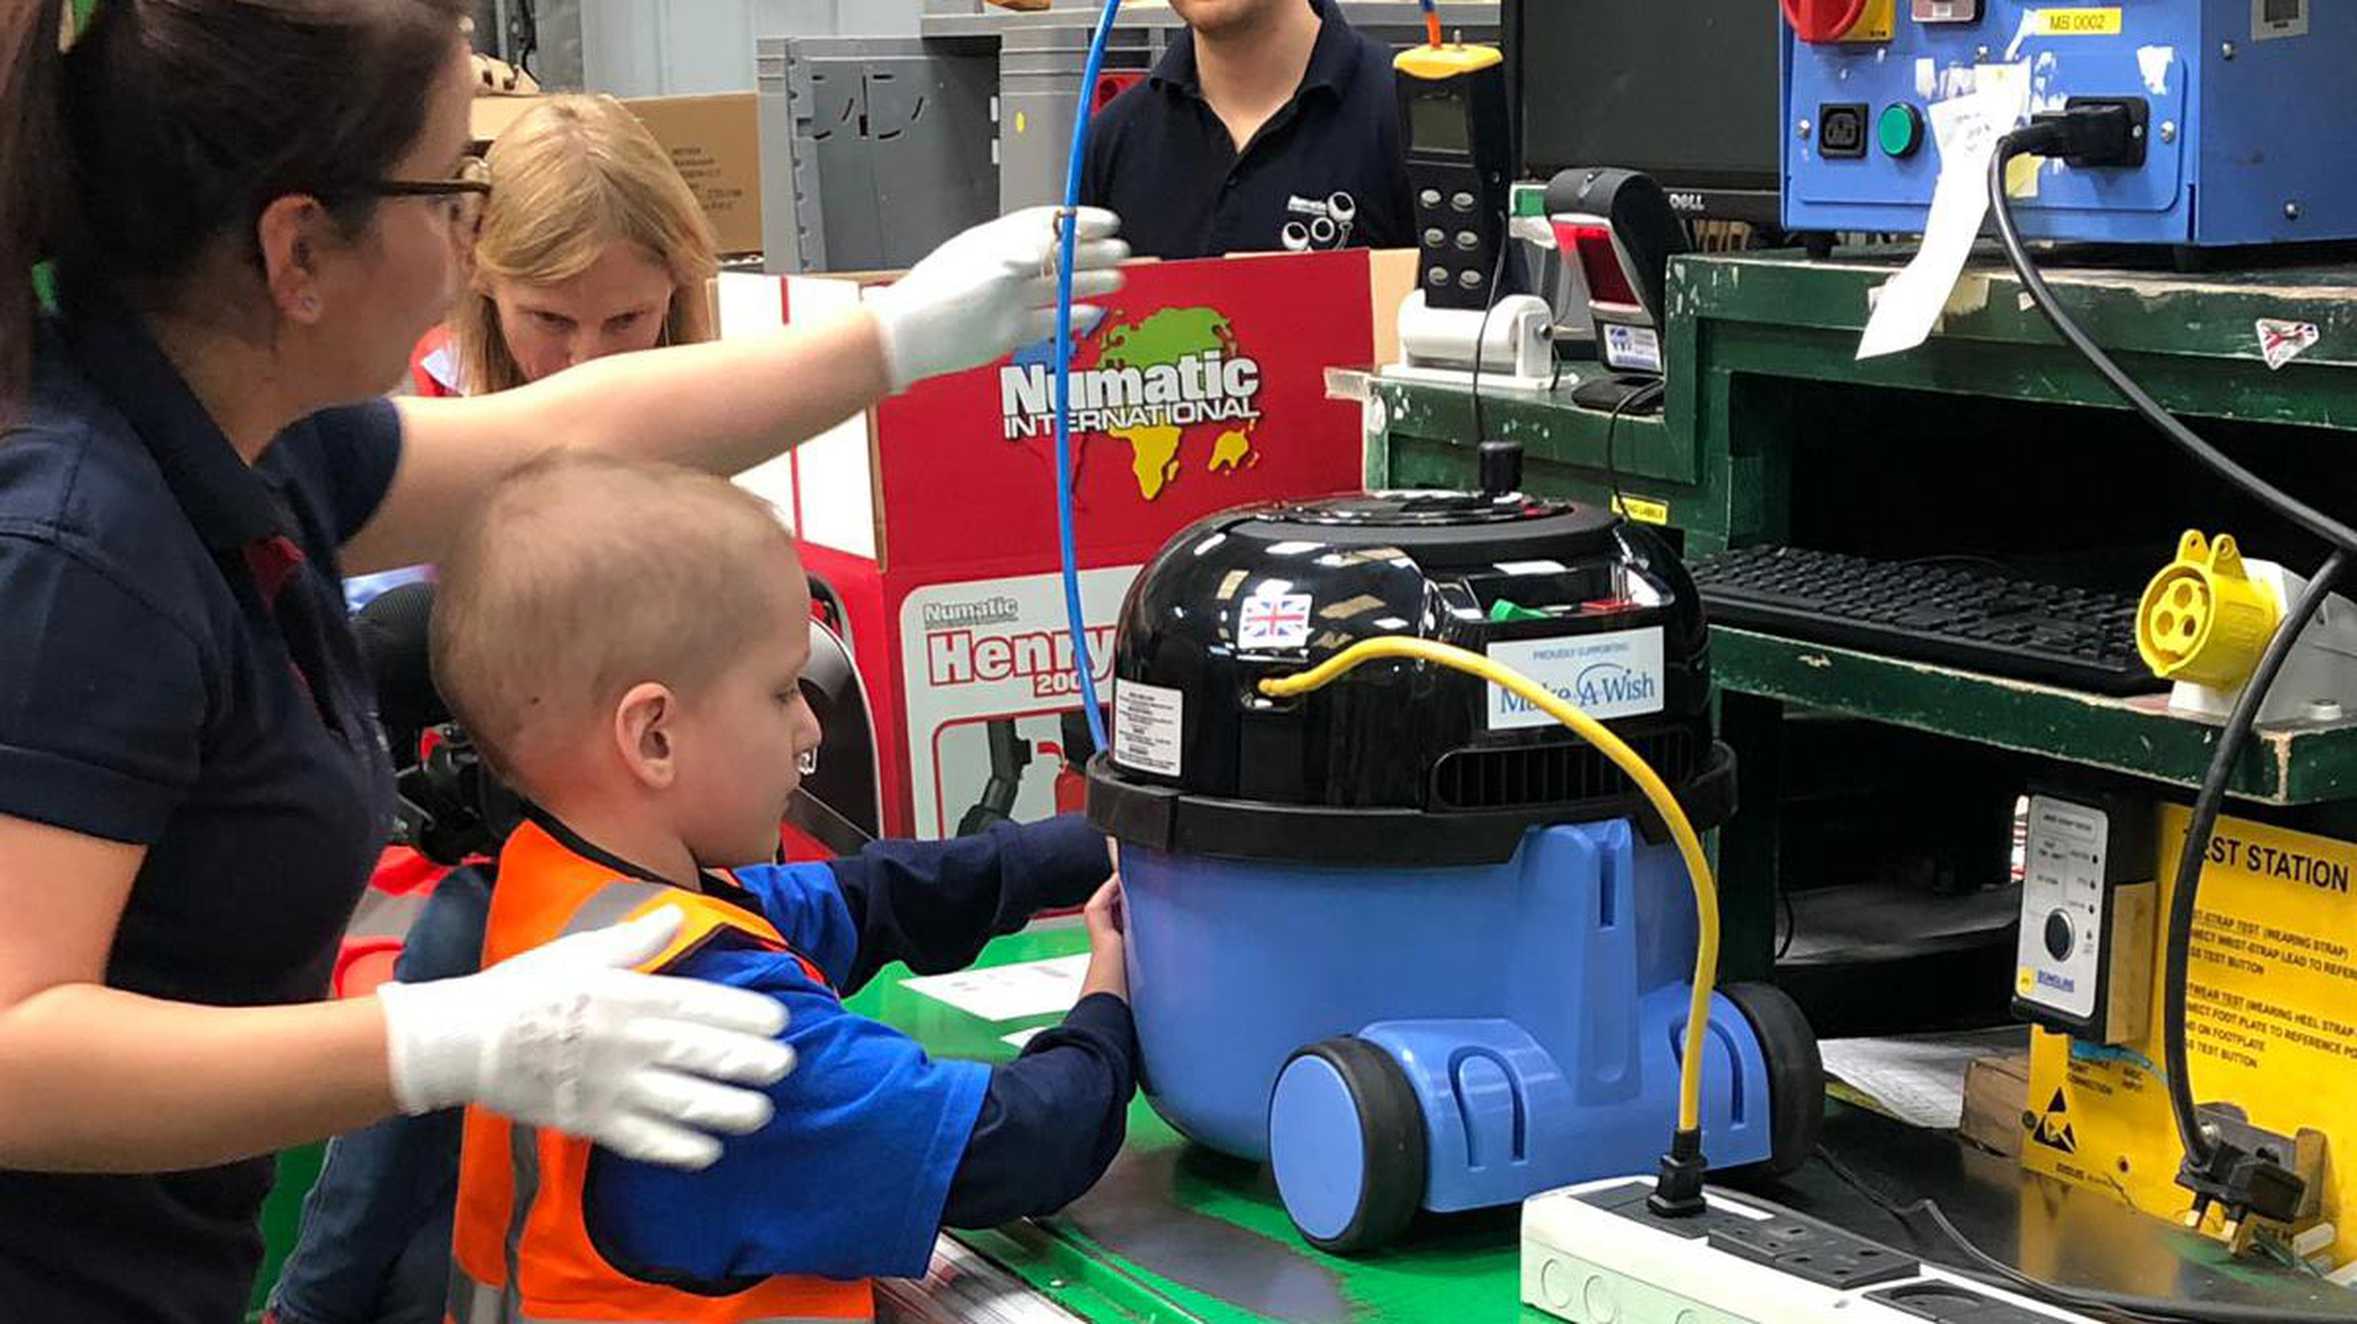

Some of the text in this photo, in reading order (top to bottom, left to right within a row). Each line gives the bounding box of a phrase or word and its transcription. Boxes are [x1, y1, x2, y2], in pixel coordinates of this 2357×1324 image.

[1669, 193, 1704, 210] DELL
[999, 350, 1260, 416] Numatic
[924, 596, 1019, 622] Numatic
[927, 625, 1116, 686] Henry
[2247, 844, 2349, 893] STATION
